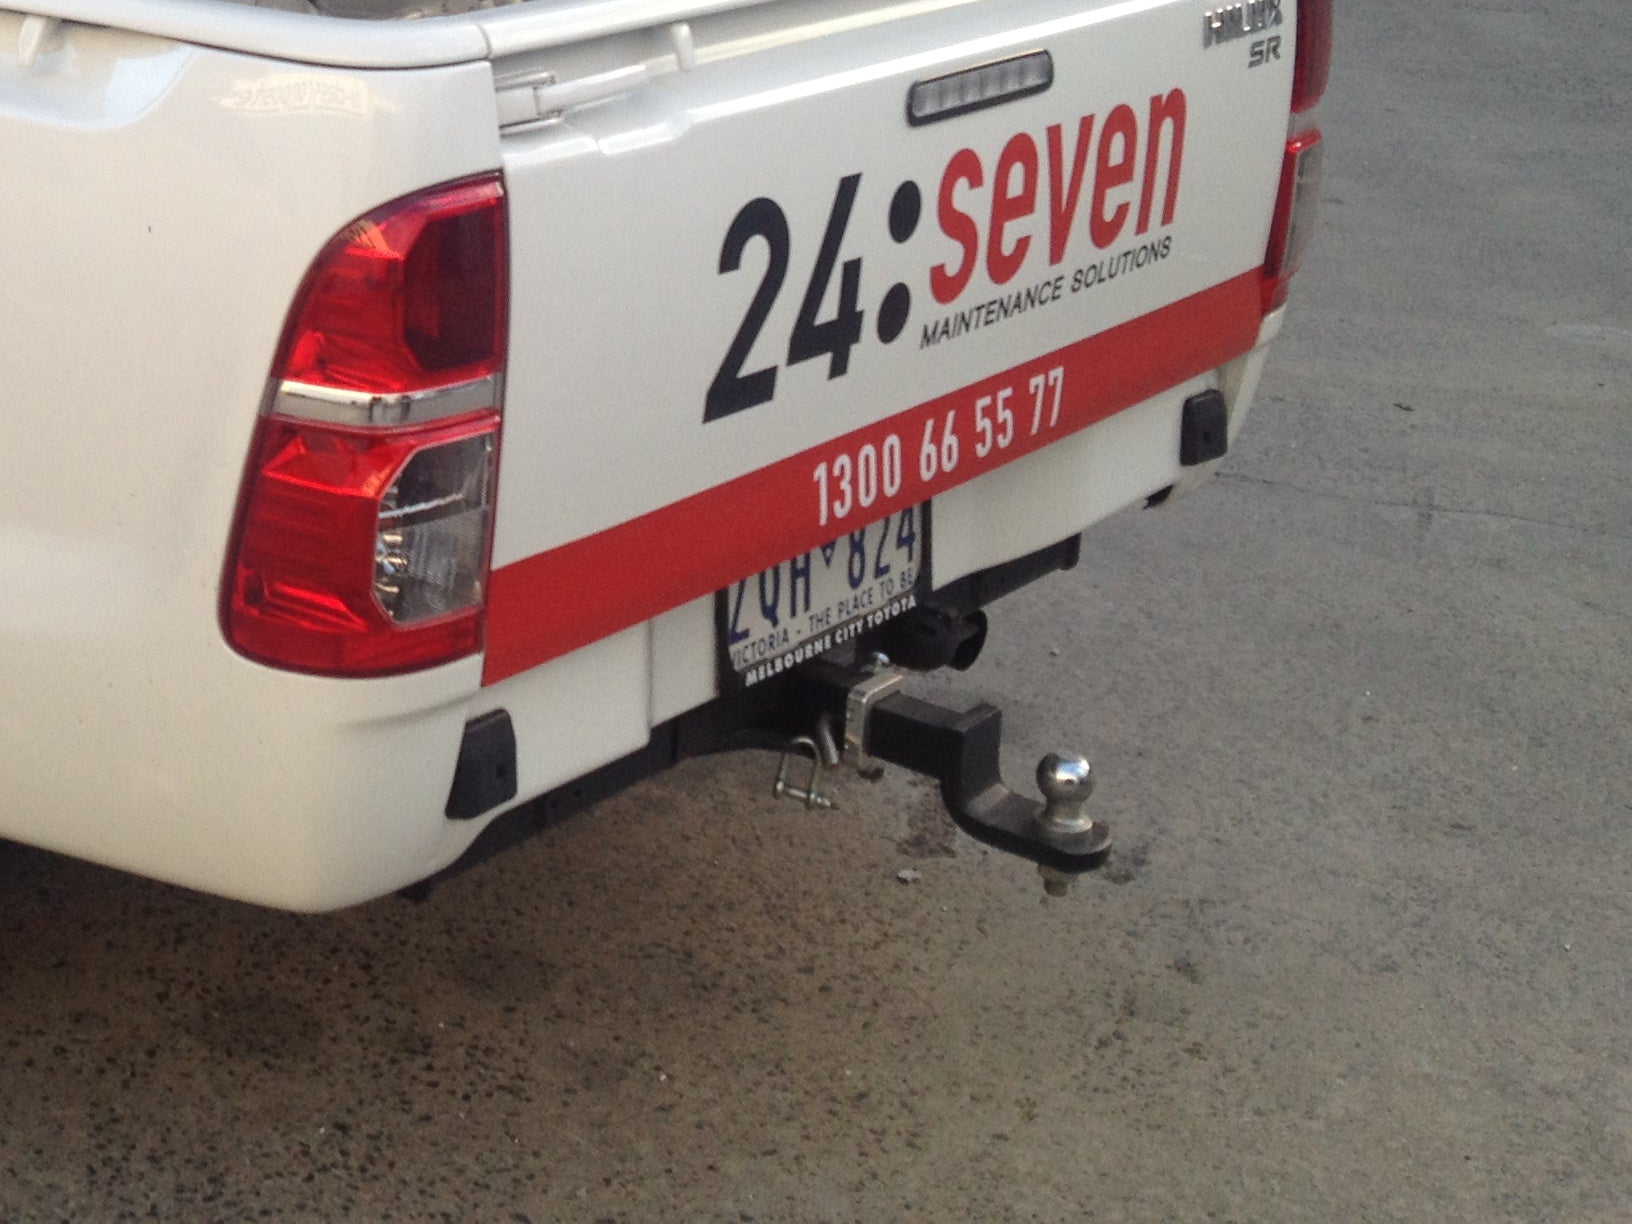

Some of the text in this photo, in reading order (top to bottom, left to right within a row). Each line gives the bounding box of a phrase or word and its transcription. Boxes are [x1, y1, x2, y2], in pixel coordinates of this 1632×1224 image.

[1247, 35, 1282, 69] SR
[919, 235, 1173, 349] MAINTENANCE SOLUTIONS
[813, 366, 1065, 526] 1300 66 55 77
[744, 593, 917, 687] MELBOURNE CITY TOYOTA
[808, 607, 831, 634] THE
[837, 586, 874, 618] PLACE
[879, 576, 895, 599] TO
